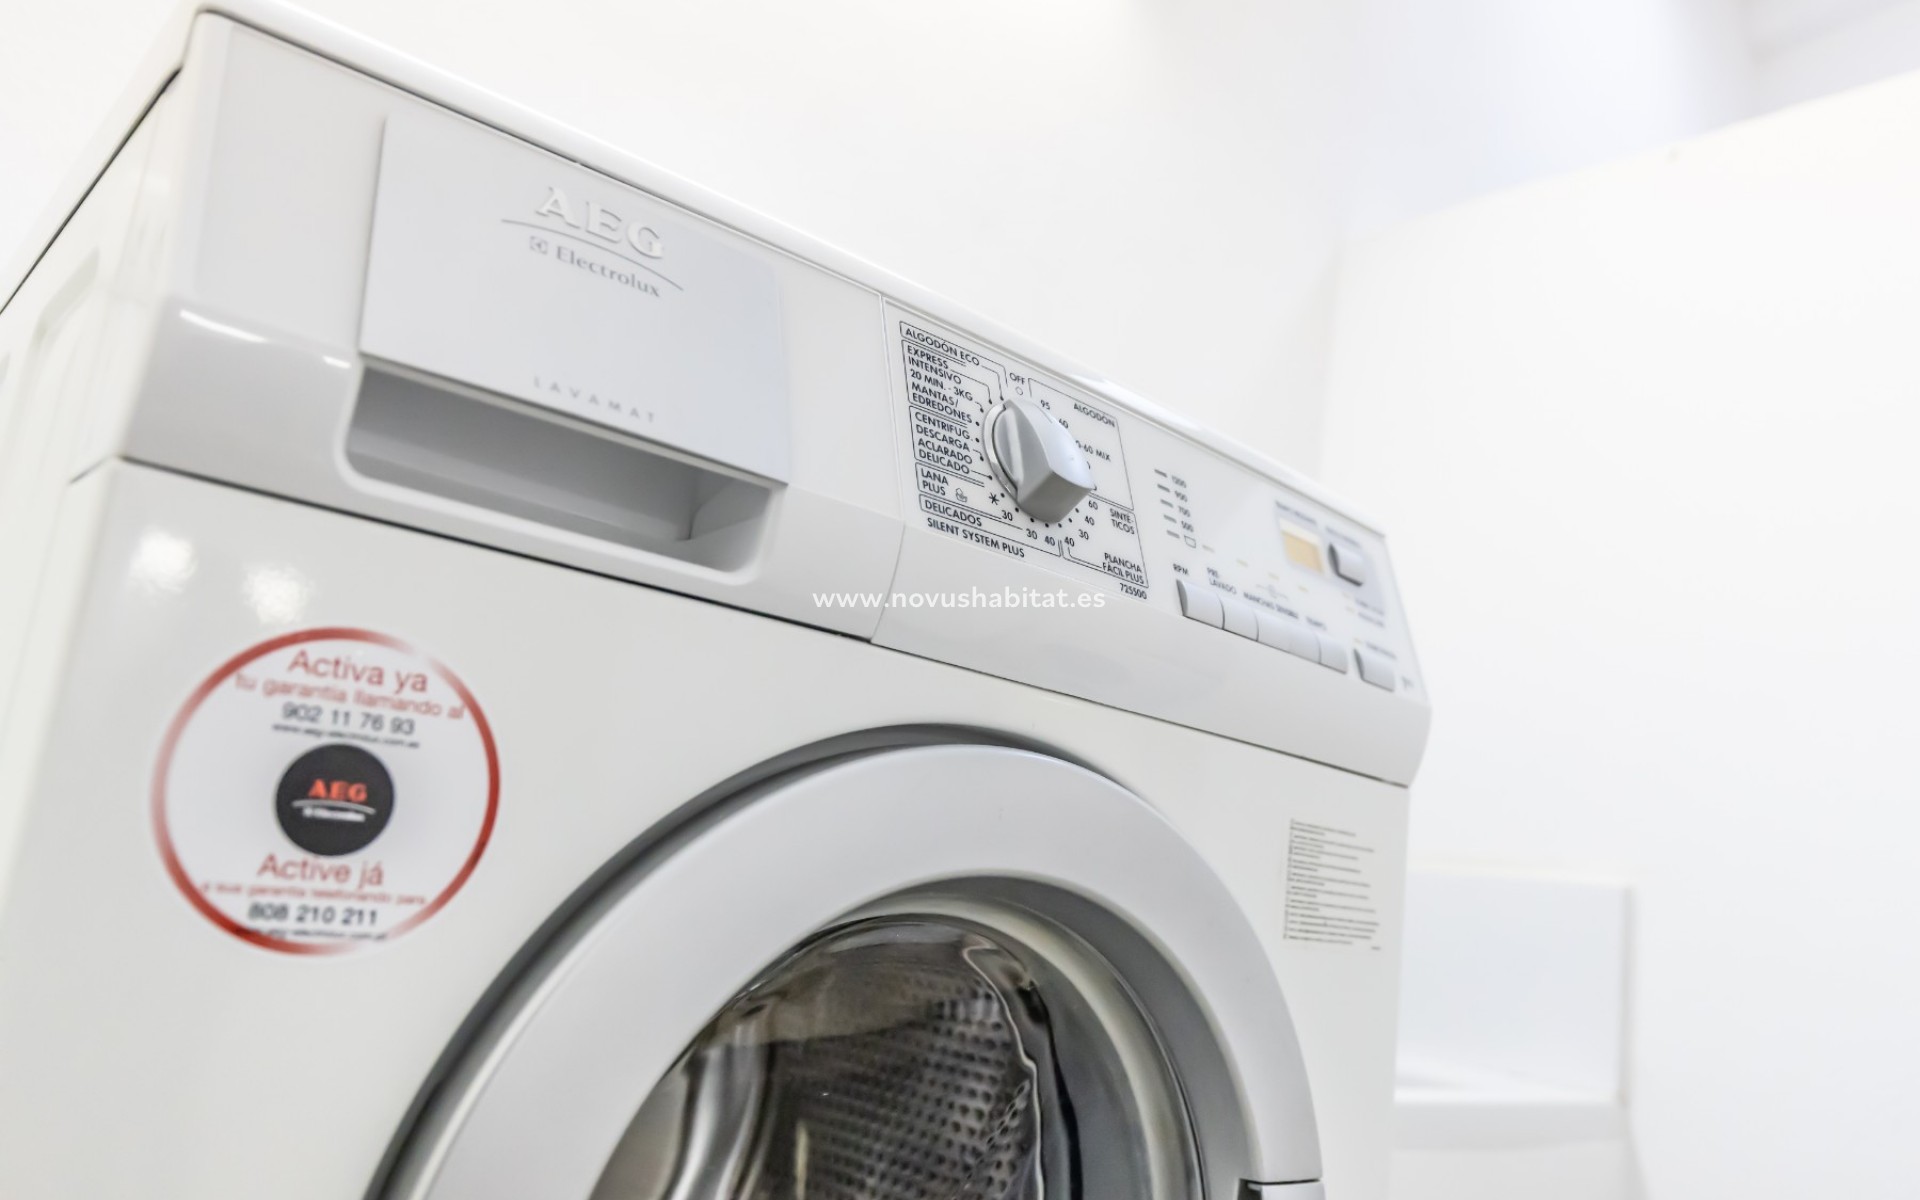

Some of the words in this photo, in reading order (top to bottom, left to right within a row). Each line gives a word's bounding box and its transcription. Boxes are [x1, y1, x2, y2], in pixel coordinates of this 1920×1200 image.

[535, 184, 664, 260] AEG
[556, 245, 661, 299] Electrolux
[905, 327, 958, 357] ALGODÓN
[959, 350, 980, 366] ECO
[907, 344, 949, 370] EXPRESS
[908, 355, 962, 385] INTENSIVO
[1009, 372, 1026, 385] OFF
[911, 368, 922, 381] 20
[953, 385, 973, 401] 3KG
[912, 381, 959, 408] MANTAS/
[533, 374, 656, 424] LAVAMAT
[912, 391, 973, 424] EDREDONES
[1040, 399, 1051, 411] 95
[915, 423, 971, 453] DESCARGA
[918, 437, 973, 465] ACLARADO
[919, 448, 970, 475] DELICADO
[1095, 449, 1112, 462] MIX
[921, 467, 949, 487] LANA
[922, 479, 946, 496] PLUS
[924, 499, 983, 527] DELICADOS
[1001, 509, 1014, 522] 30
[1088, 500, 1099, 511] 60
[1084, 515, 1095, 527] 40
[1110, 518, 1136, 536] TICOS
[927, 517, 960, 536] SILENT
[962, 529, 1001, 551] SYSTEM
[1002, 541, 1026, 559] PLUS
[1026, 528, 1038, 541] 30
[1044, 535, 1056, 547] 40
[1064, 536, 1075, 548] 40
[1078, 528, 1090, 541] 30
[1103, 551, 1143, 574] PLANCHA
[1124, 569, 1145, 586] PLUS
[1119, 582, 1148, 601] 725500
[286, 648, 385, 686] Activa
[394, 669, 429, 696] ya
[354, 687, 443, 717] llamando
[282, 701, 323, 723] 902
[331, 709, 351, 727] 11
[359, 712, 385, 732] 76
[389, 717, 416, 736] 93
[308, 778, 369, 804] AEG
[256, 853, 353, 883] Active
[358, 861, 384, 890] já
[247, 901, 290, 922] 808
[295, 904, 338, 925] 210
[340, 907, 377, 927] 211
